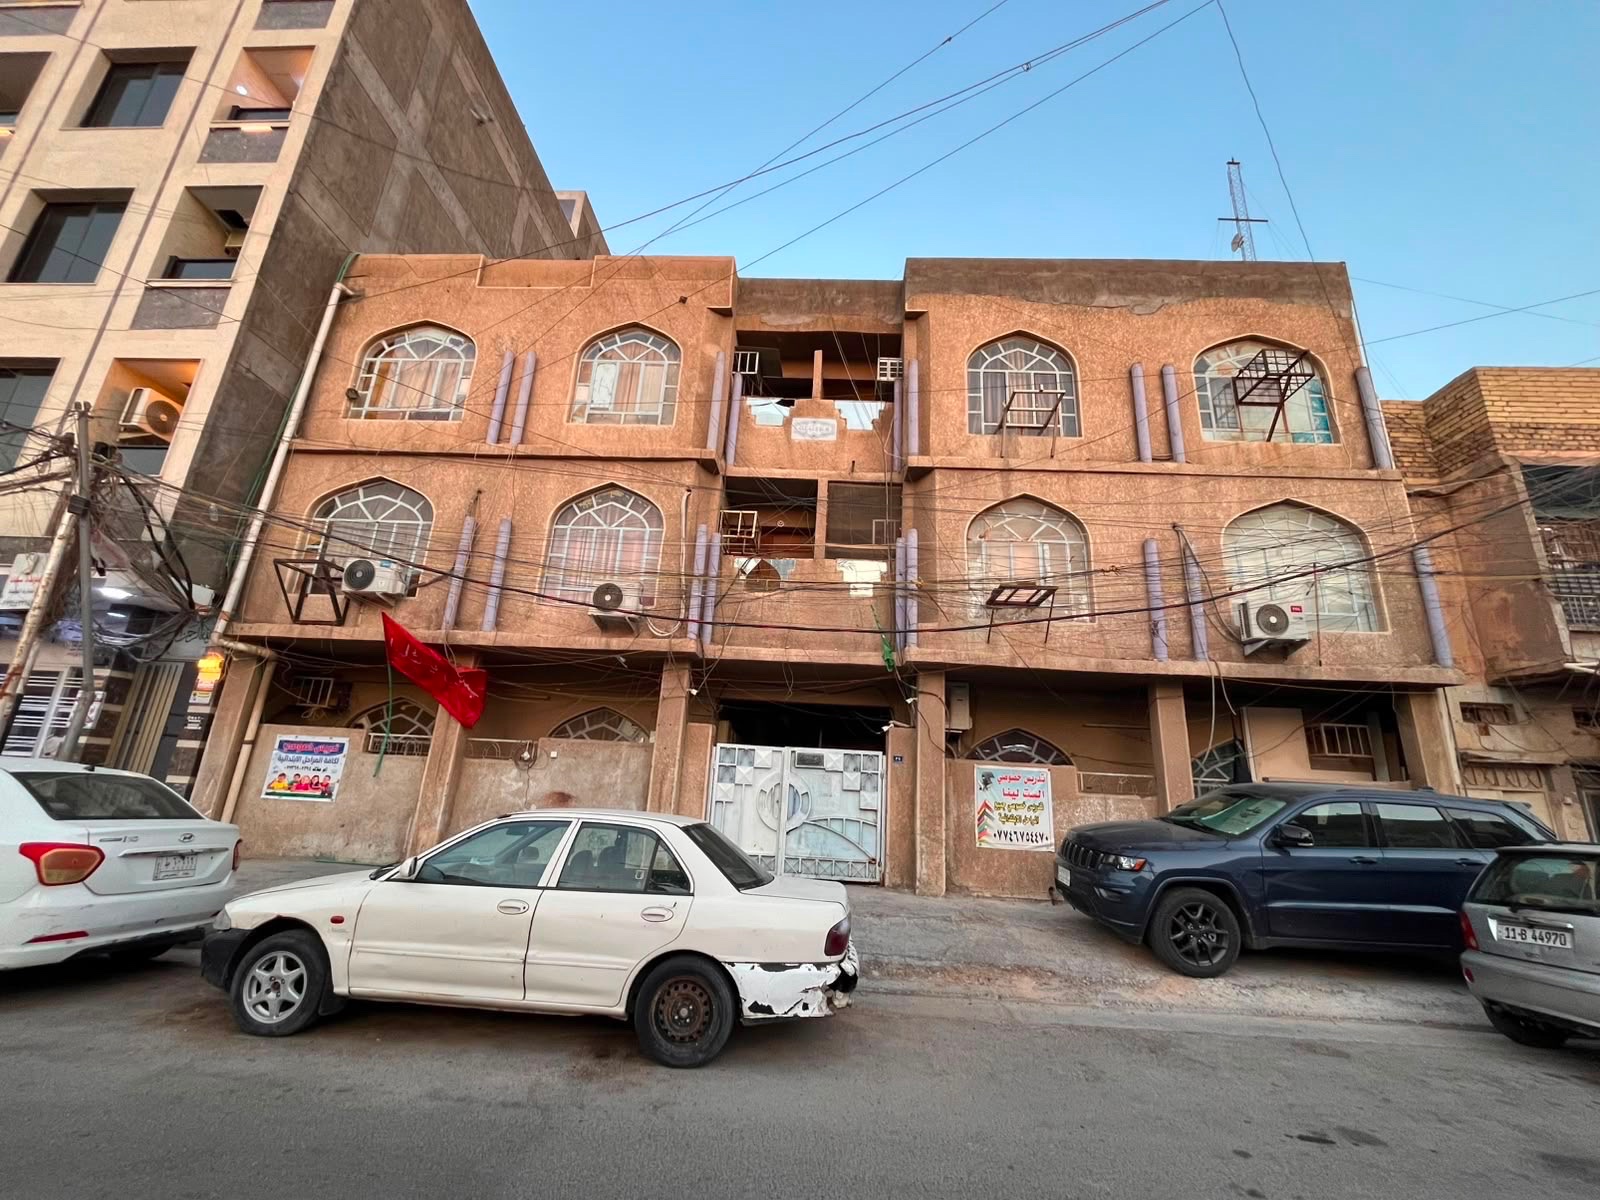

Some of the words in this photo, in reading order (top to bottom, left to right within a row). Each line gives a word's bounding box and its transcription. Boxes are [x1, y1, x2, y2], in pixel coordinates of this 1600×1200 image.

[302, 756, 323, 765] المراحل
[997, 774, 1022, 784] خصوصي
[1023, 773, 1046, 785] تدريس
[1002, 787, 1019, 800] لينا
[1022, 788, 1045, 799] الست
[993, 829, 1049, 844] ٠٧٧٤٦٧٥٤٤٧٠
[1531, 928, 1567, 946] 44970
